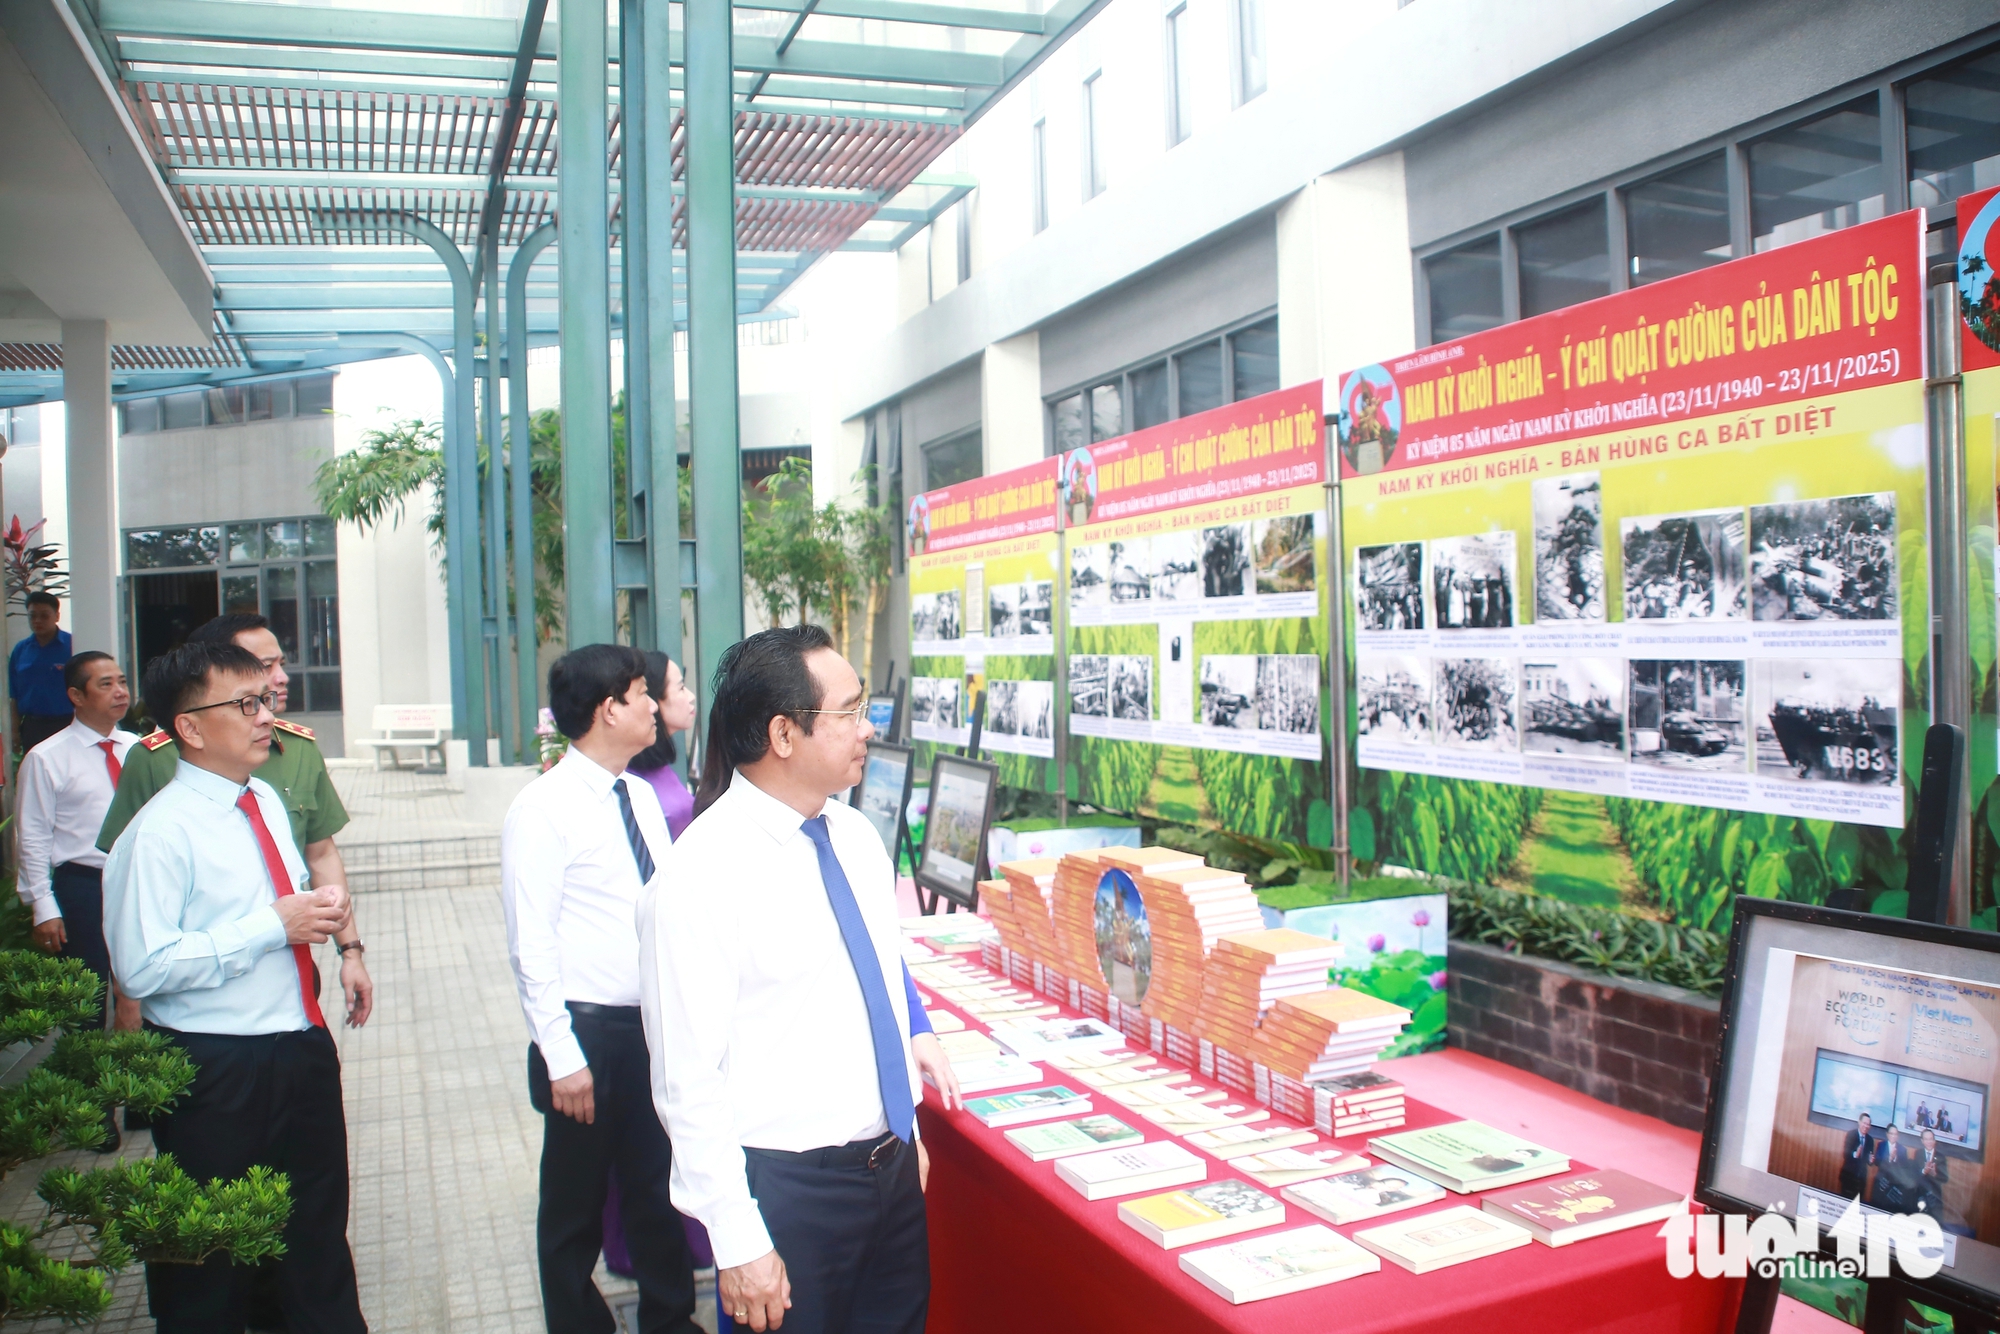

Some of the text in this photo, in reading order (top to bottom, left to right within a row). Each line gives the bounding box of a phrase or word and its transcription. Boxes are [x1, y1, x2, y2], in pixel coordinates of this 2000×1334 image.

[1405, 381, 1436, 424] NAM
[1437, 366, 1455, 417] KỲ
[1458, 354, 1494, 413] KHỞI
[1496, 345, 1544, 405] NGHĨA
[1560, 335, 1572, 390] Ý
[1576, 325, 1607, 388] CHÍ
[1611, 315, 1660, 385] QUẬT
[1665, 302, 1736, 369] CƯỜNG
[1741, 281, 1787, 351] CỦA
[1793, 271, 1841, 341] DÂN
[1847, 256, 1899, 336] TỘC
[1492, 418, 1523, 444] NGÀY
[1524, 416, 1553, 438] NAM
[1553, 407, 1572, 433] KỲ
[1574, 399, 1612, 429] KHỞI
[1612, 391, 1658, 421] NGHĨA
[1661, 375, 1763, 418] (23/11/1940
[1779, 348, 1900, 395] 23/11/2025)
[1378, 477, 1411, 496] NAM
[1416, 471, 1435, 490] KỲ
[1441, 461, 1479, 486] KHỞI
[1485, 453, 1540, 480] NGHĨA
[1561, 443, 1600, 468] BẢN
[1608, 435, 1669, 460] HÙNG
[1677, 428, 1710, 451] CA
[1717, 411, 1766, 445] BẤT
[1775, 405, 1837, 435] DIỆT
[1838, 989, 1886, 1008] WORLD
[1825, 999, 1897, 1024] ECONOMIC
[1914, 1002, 1973, 1027] Viet Nam
[1834, 1014, 1882, 1035] FORUM
